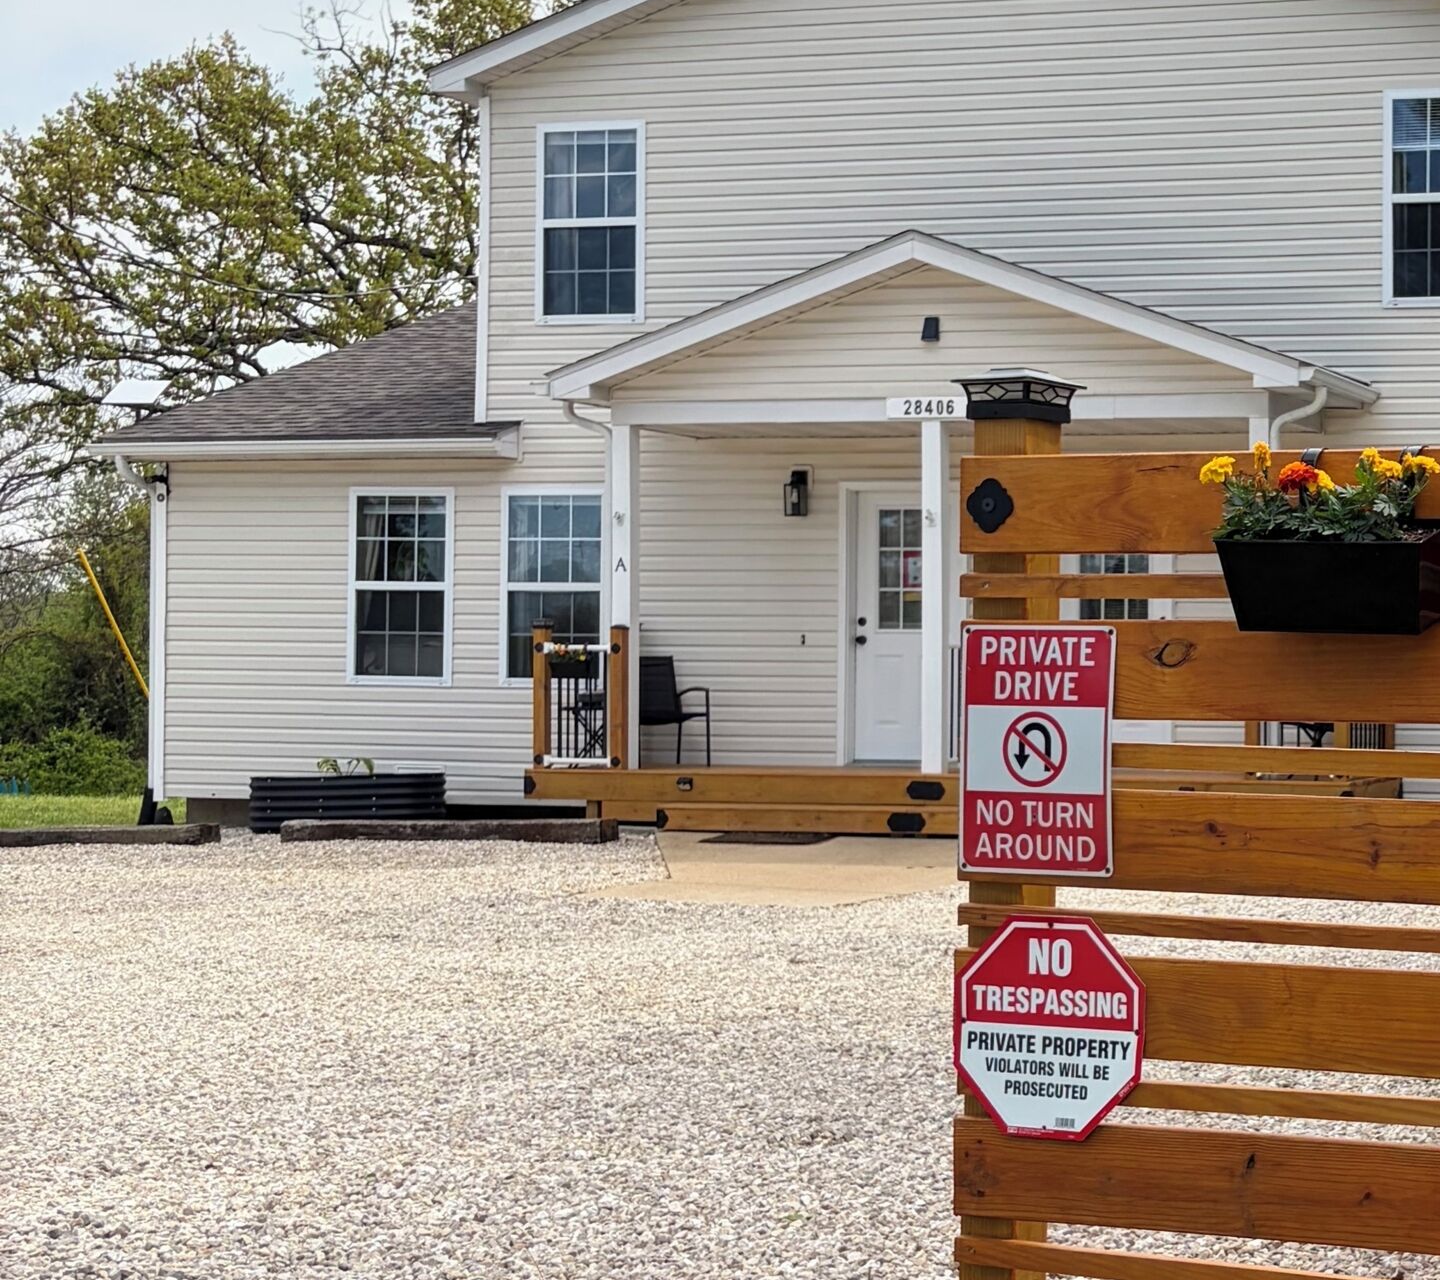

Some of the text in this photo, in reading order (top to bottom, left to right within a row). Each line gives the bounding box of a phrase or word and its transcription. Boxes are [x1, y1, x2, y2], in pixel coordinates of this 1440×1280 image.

[904, 400, 954, 415] 28406
[615, 556, 627, 573] A
[981, 636, 1096, 666] PRIVATE
[994, 671, 1079, 701] DRIVE
[976, 799, 1094, 829] NO TURN
[975, 832, 1096, 862] AROUND
[1028, 938, 1072, 977] NO
[972, 984, 1128, 1020] TRESPASSING
[967, 1031, 1131, 1061] PRIVATE PROPERTY
[985, 1057, 1110, 1080] VIOLATORS WILL BE
[1004, 1080, 1088, 1100] PROSECUTED
